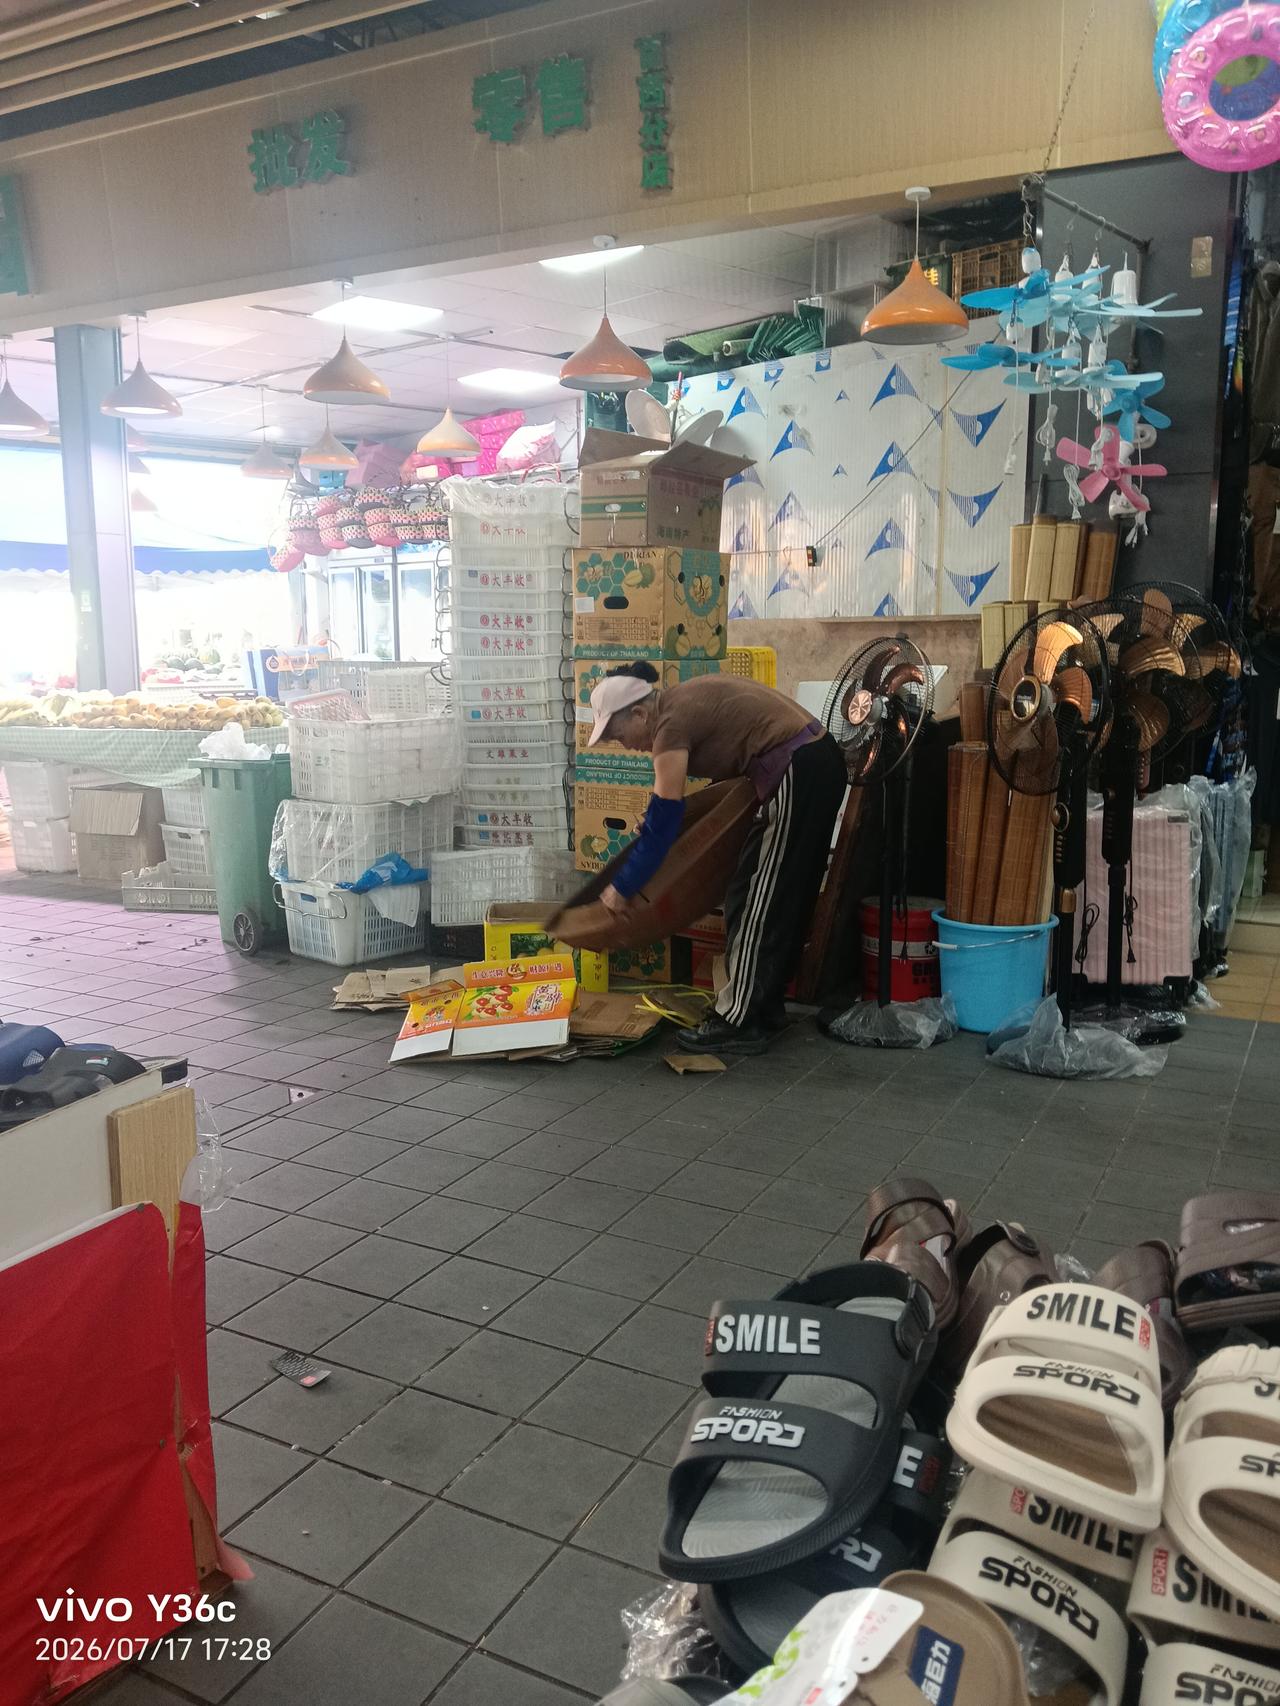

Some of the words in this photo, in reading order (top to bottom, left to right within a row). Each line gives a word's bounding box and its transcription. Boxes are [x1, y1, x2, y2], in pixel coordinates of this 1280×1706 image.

[247, 108, 350, 193] 批发
[471, 53, 587, 142] 零售
[492, 613, 525, 628] 大丰收
[492, 636, 526, 651] 大丰收
[585, 758, 611, 766] PRODUCT
[612, 759, 620, 767] OF
[501, 812, 534, 826] 大丰收
[580, 861, 606, 870] URIAN
[1026, 1292, 1137, 1340] SMILE
[715, 1314, 821, 1355] SMILE
[1044, 1361, 1115, 1379] FASHION
[719, 1406, 783, 1420] FASHION
[1028, 1496, 1133, 1560] SMILE
[1013, 1555, 1077, 1597] FASHION
[1210, 1664, 1280, 1692] FASHIO
